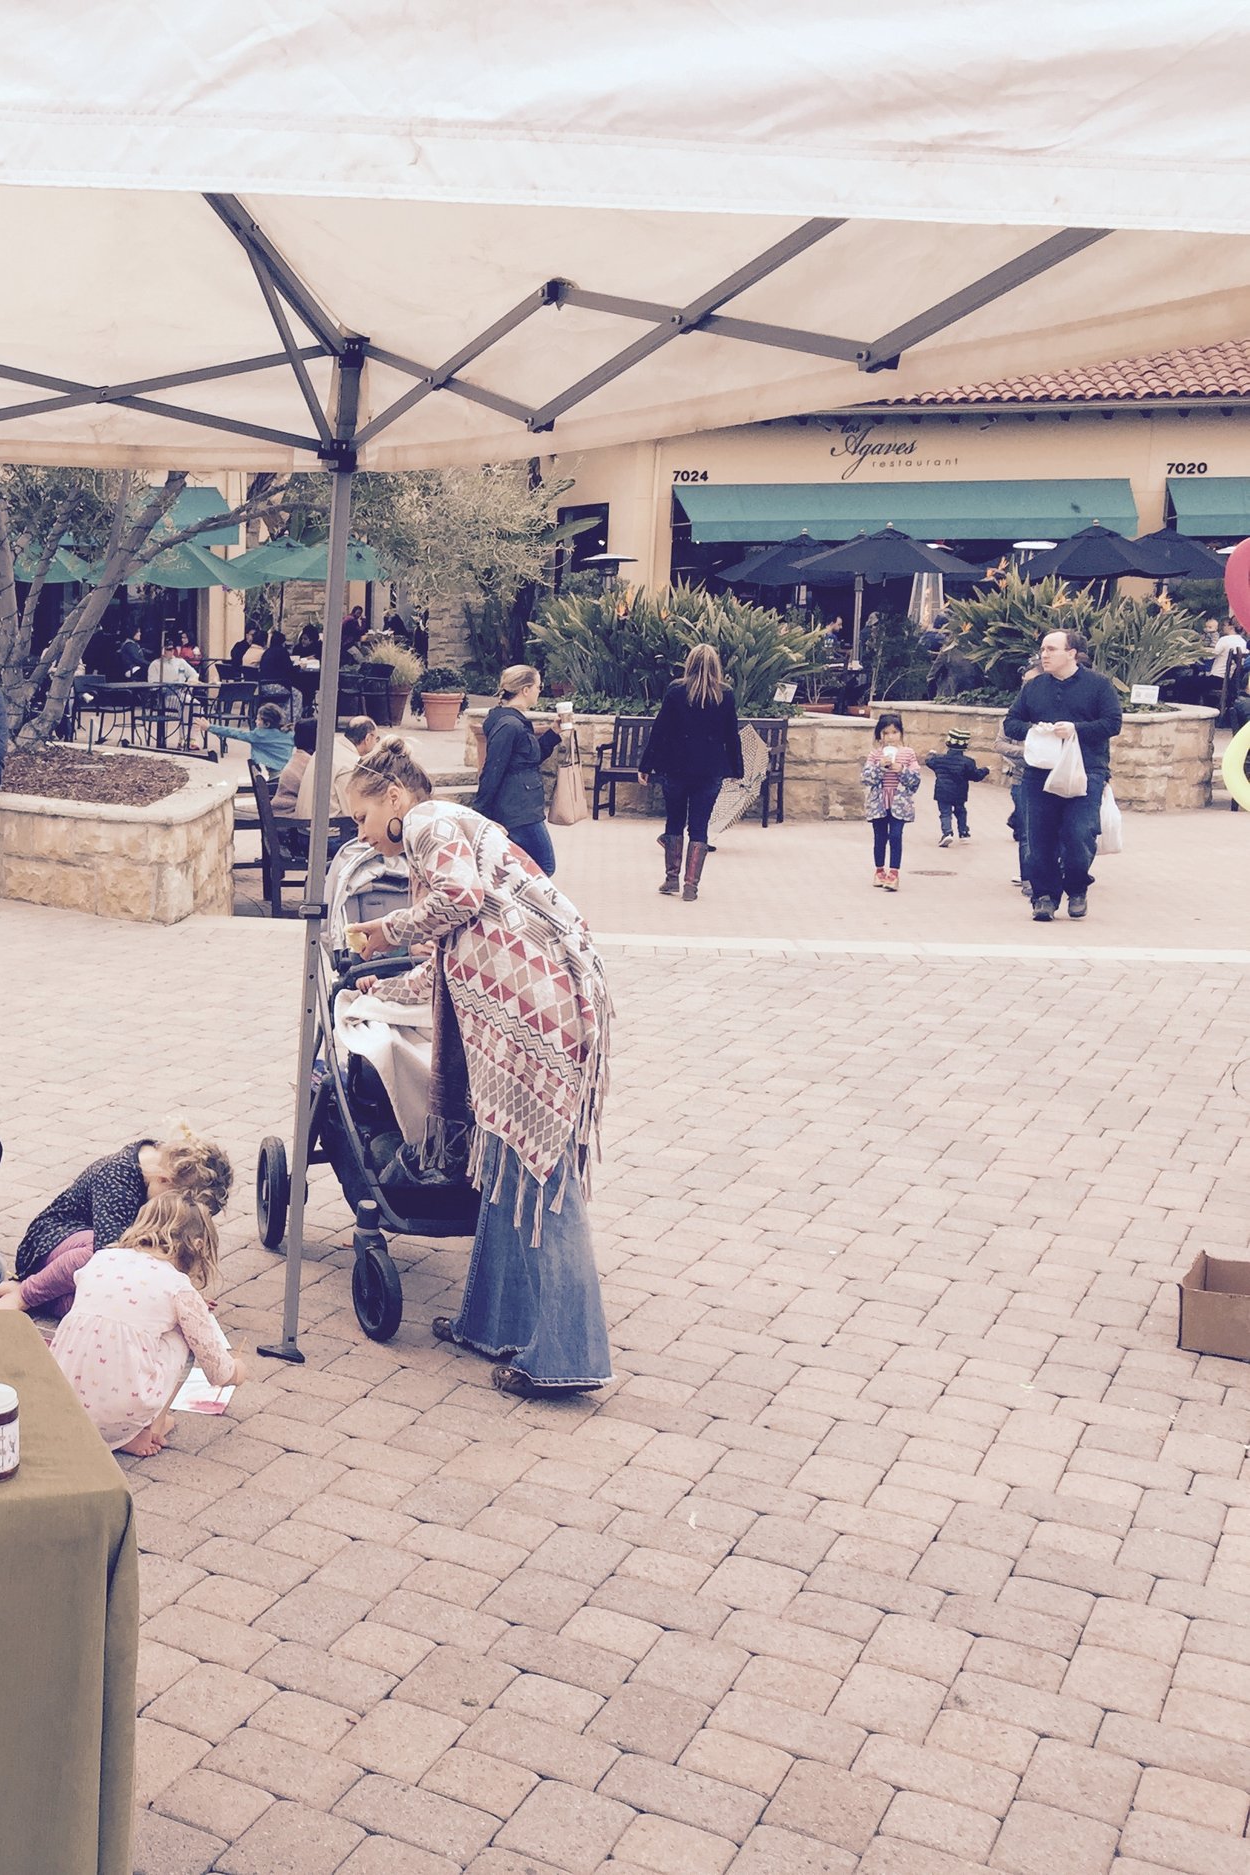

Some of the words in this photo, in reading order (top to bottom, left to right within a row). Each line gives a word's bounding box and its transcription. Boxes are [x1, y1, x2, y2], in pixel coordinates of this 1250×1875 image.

[830, 425, 918, 480] Agaves
[872, 457, 959, 468] restaurant
[1166, 462, 1208, 475] 7020
[672, 470, 709, 482] 7024
